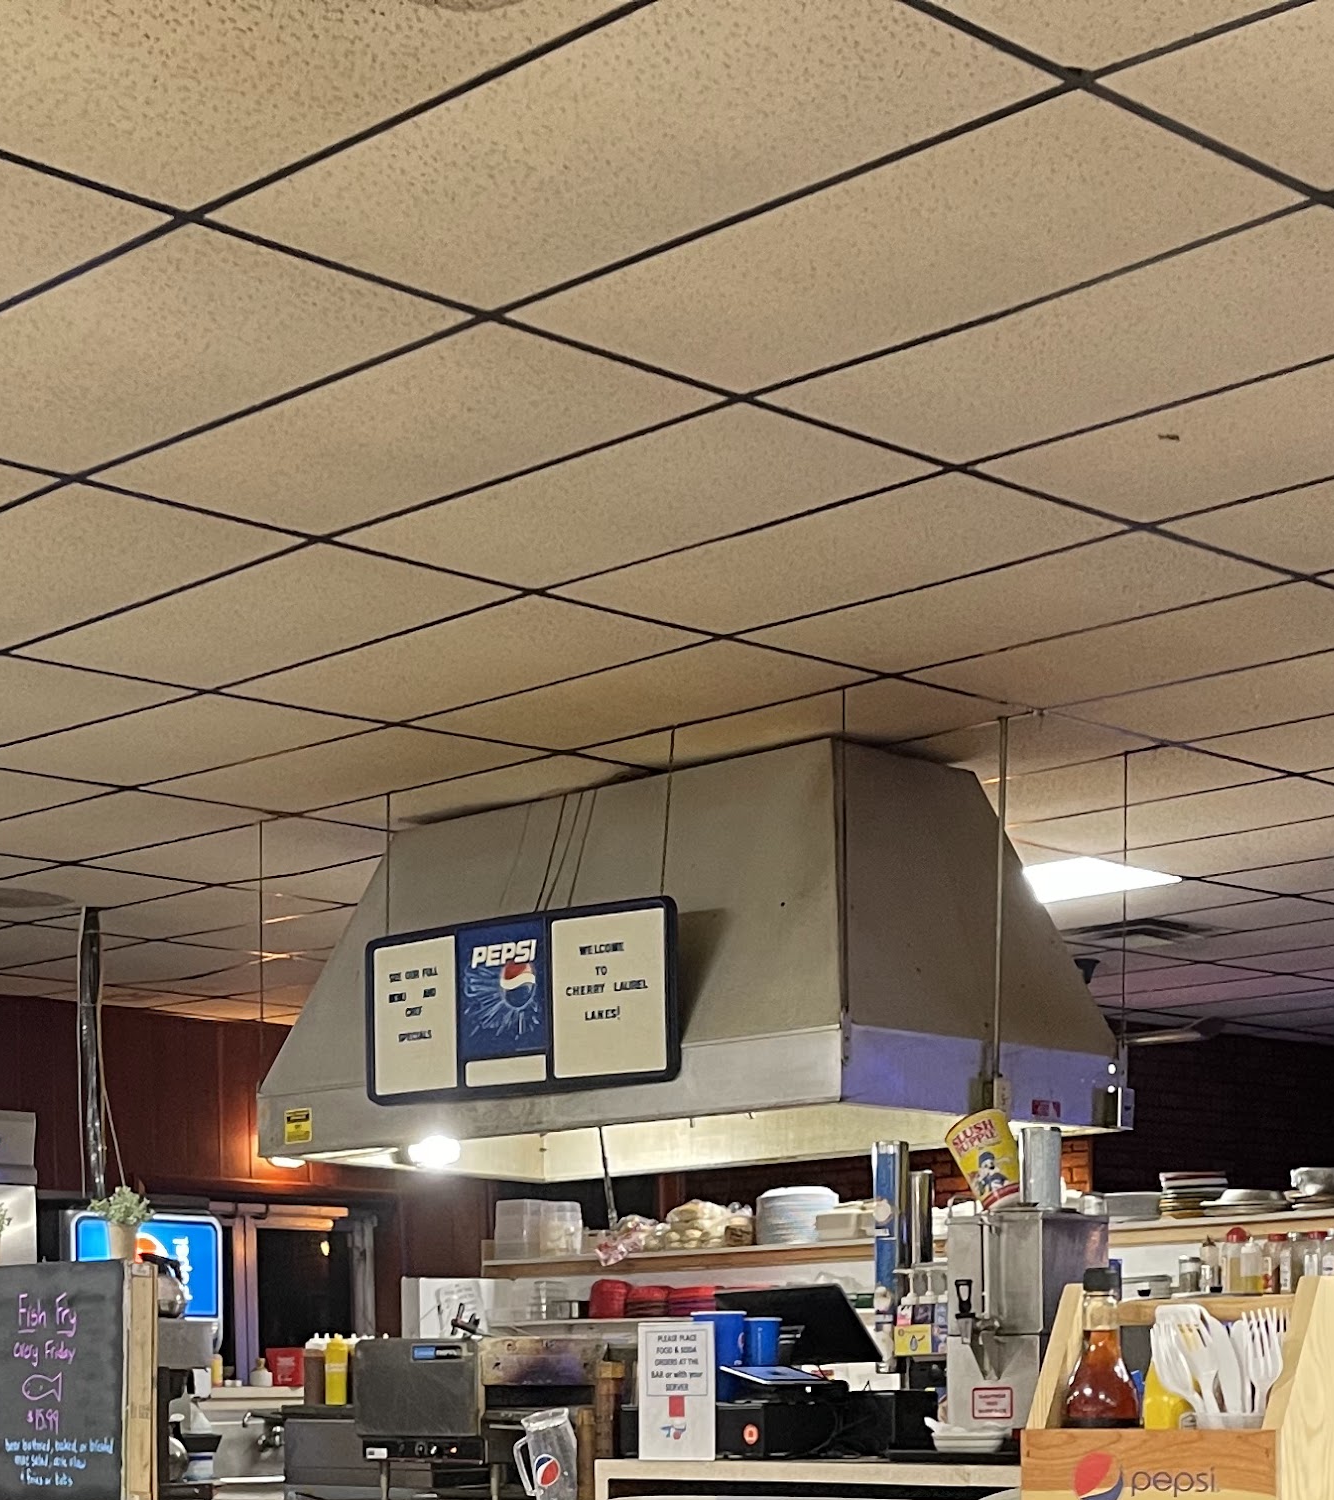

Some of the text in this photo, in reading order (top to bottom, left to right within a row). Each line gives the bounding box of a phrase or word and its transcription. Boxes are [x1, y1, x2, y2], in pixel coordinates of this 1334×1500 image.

[471, 939, 537, 969] PEPSI
[579, 941, 625, 956] WELCOME
[389, 966, 438, 983] SEE OUR FULL
[595, 966, 608, 976] TO
[565, 982, 606, 997] CHERRY
[398, 1029, 432, 1043] SPECIALS
[952, 1118, 995, 1147] SLUSH
[18, 1291, 78, 1337] Fish Fry
[658, 1334, 696, 1343] PLEASE PLACE
[44, 1339, 76, 1365] Friday
[674, 1371, 687, 1379] with
[690, 1372, 702, 1380] your
[1130, 1466, 1216, 1498] pepsi
